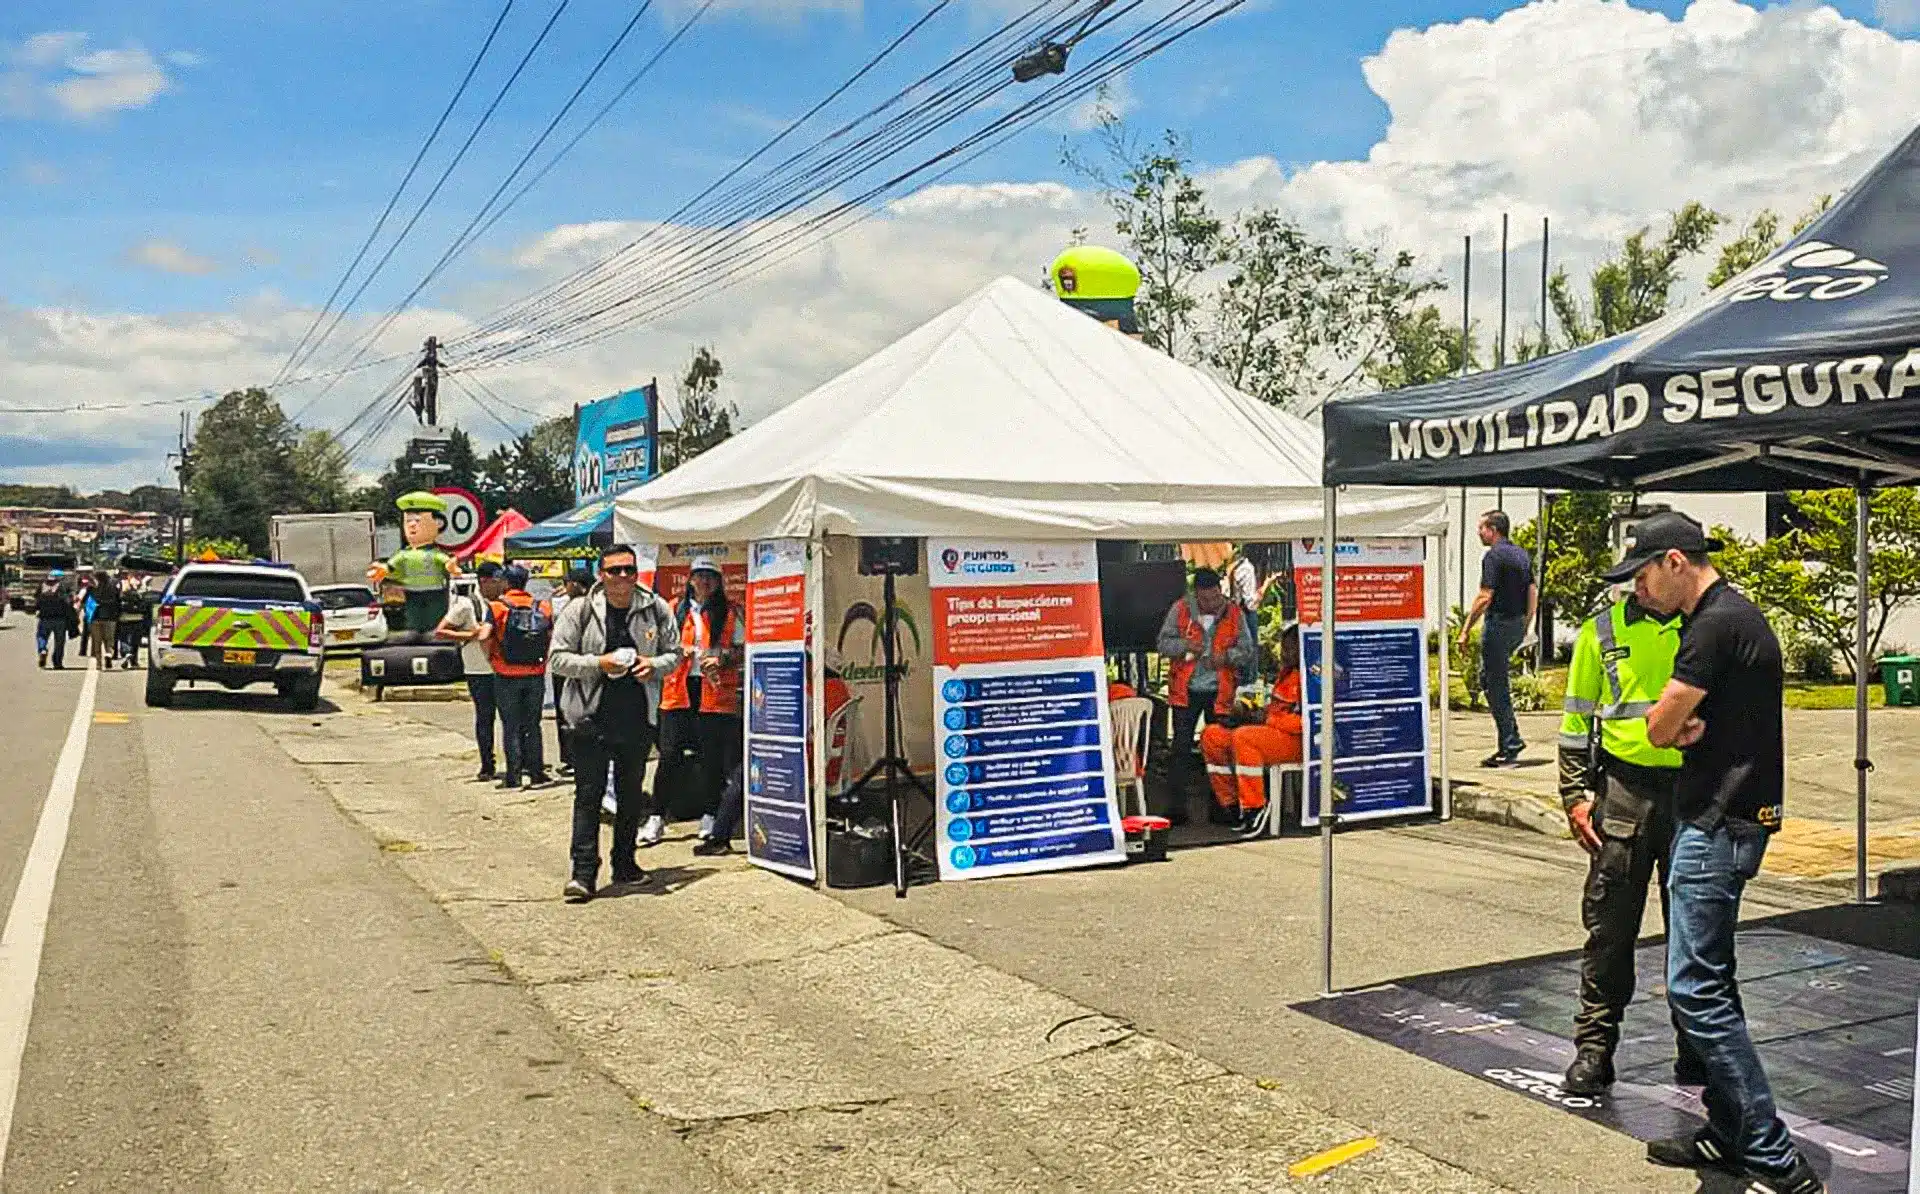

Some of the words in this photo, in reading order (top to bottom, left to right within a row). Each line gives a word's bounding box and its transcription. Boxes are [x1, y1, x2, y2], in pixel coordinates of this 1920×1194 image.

[1389, 382, 1649, 461] MOVILIDAD
[1663, 347, 1920, 424] SEGURA
[963, 550, 1009, 561] PUNTOS
